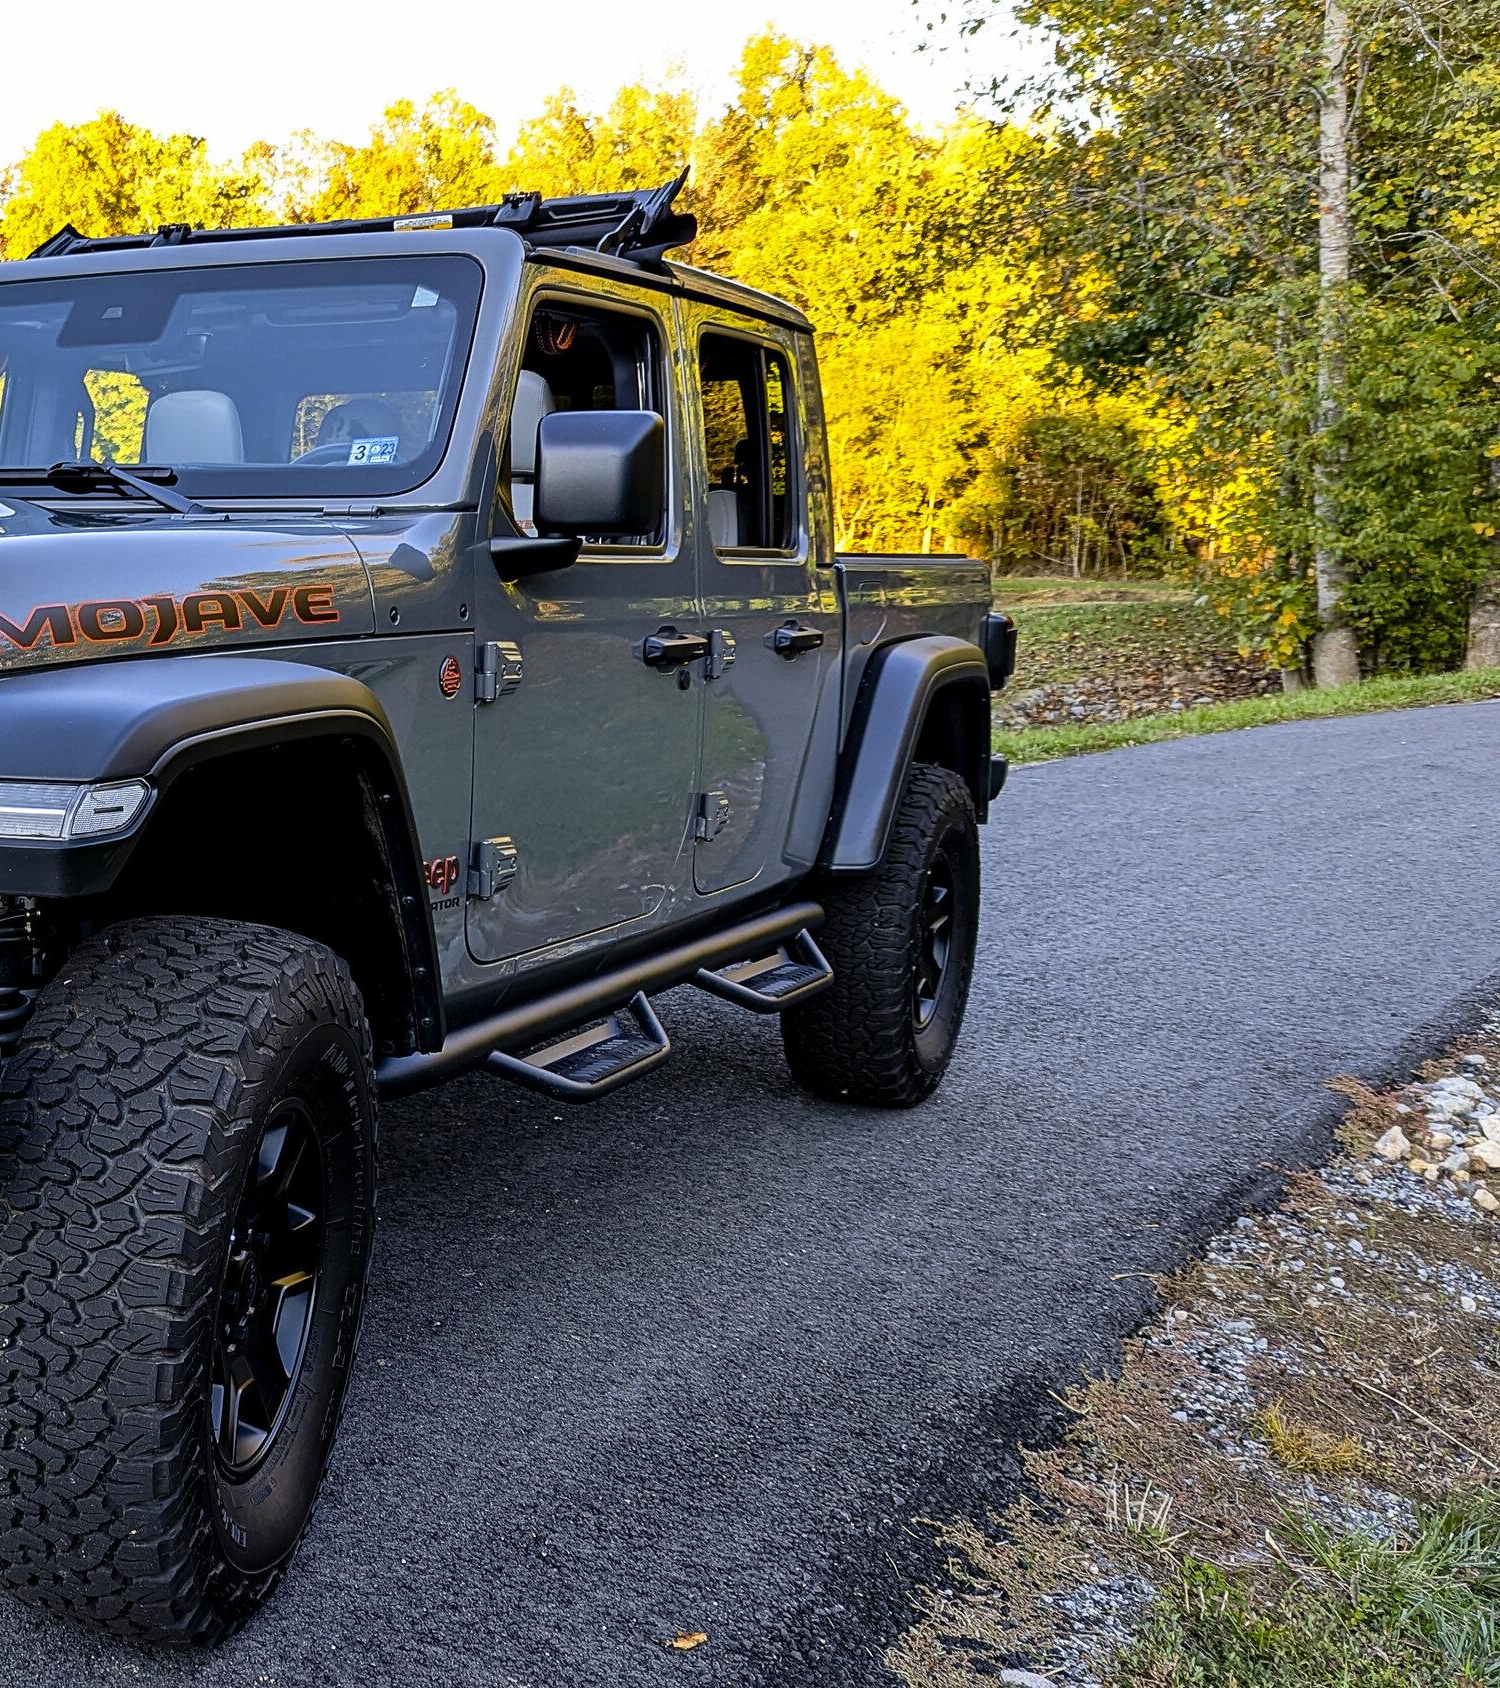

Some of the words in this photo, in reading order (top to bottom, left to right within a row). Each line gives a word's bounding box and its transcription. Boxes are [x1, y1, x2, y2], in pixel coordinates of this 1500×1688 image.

[354, 445, 367, 461] 3
[380, 443, 395, 456] 23
[422, 855, 460, 896] eep
